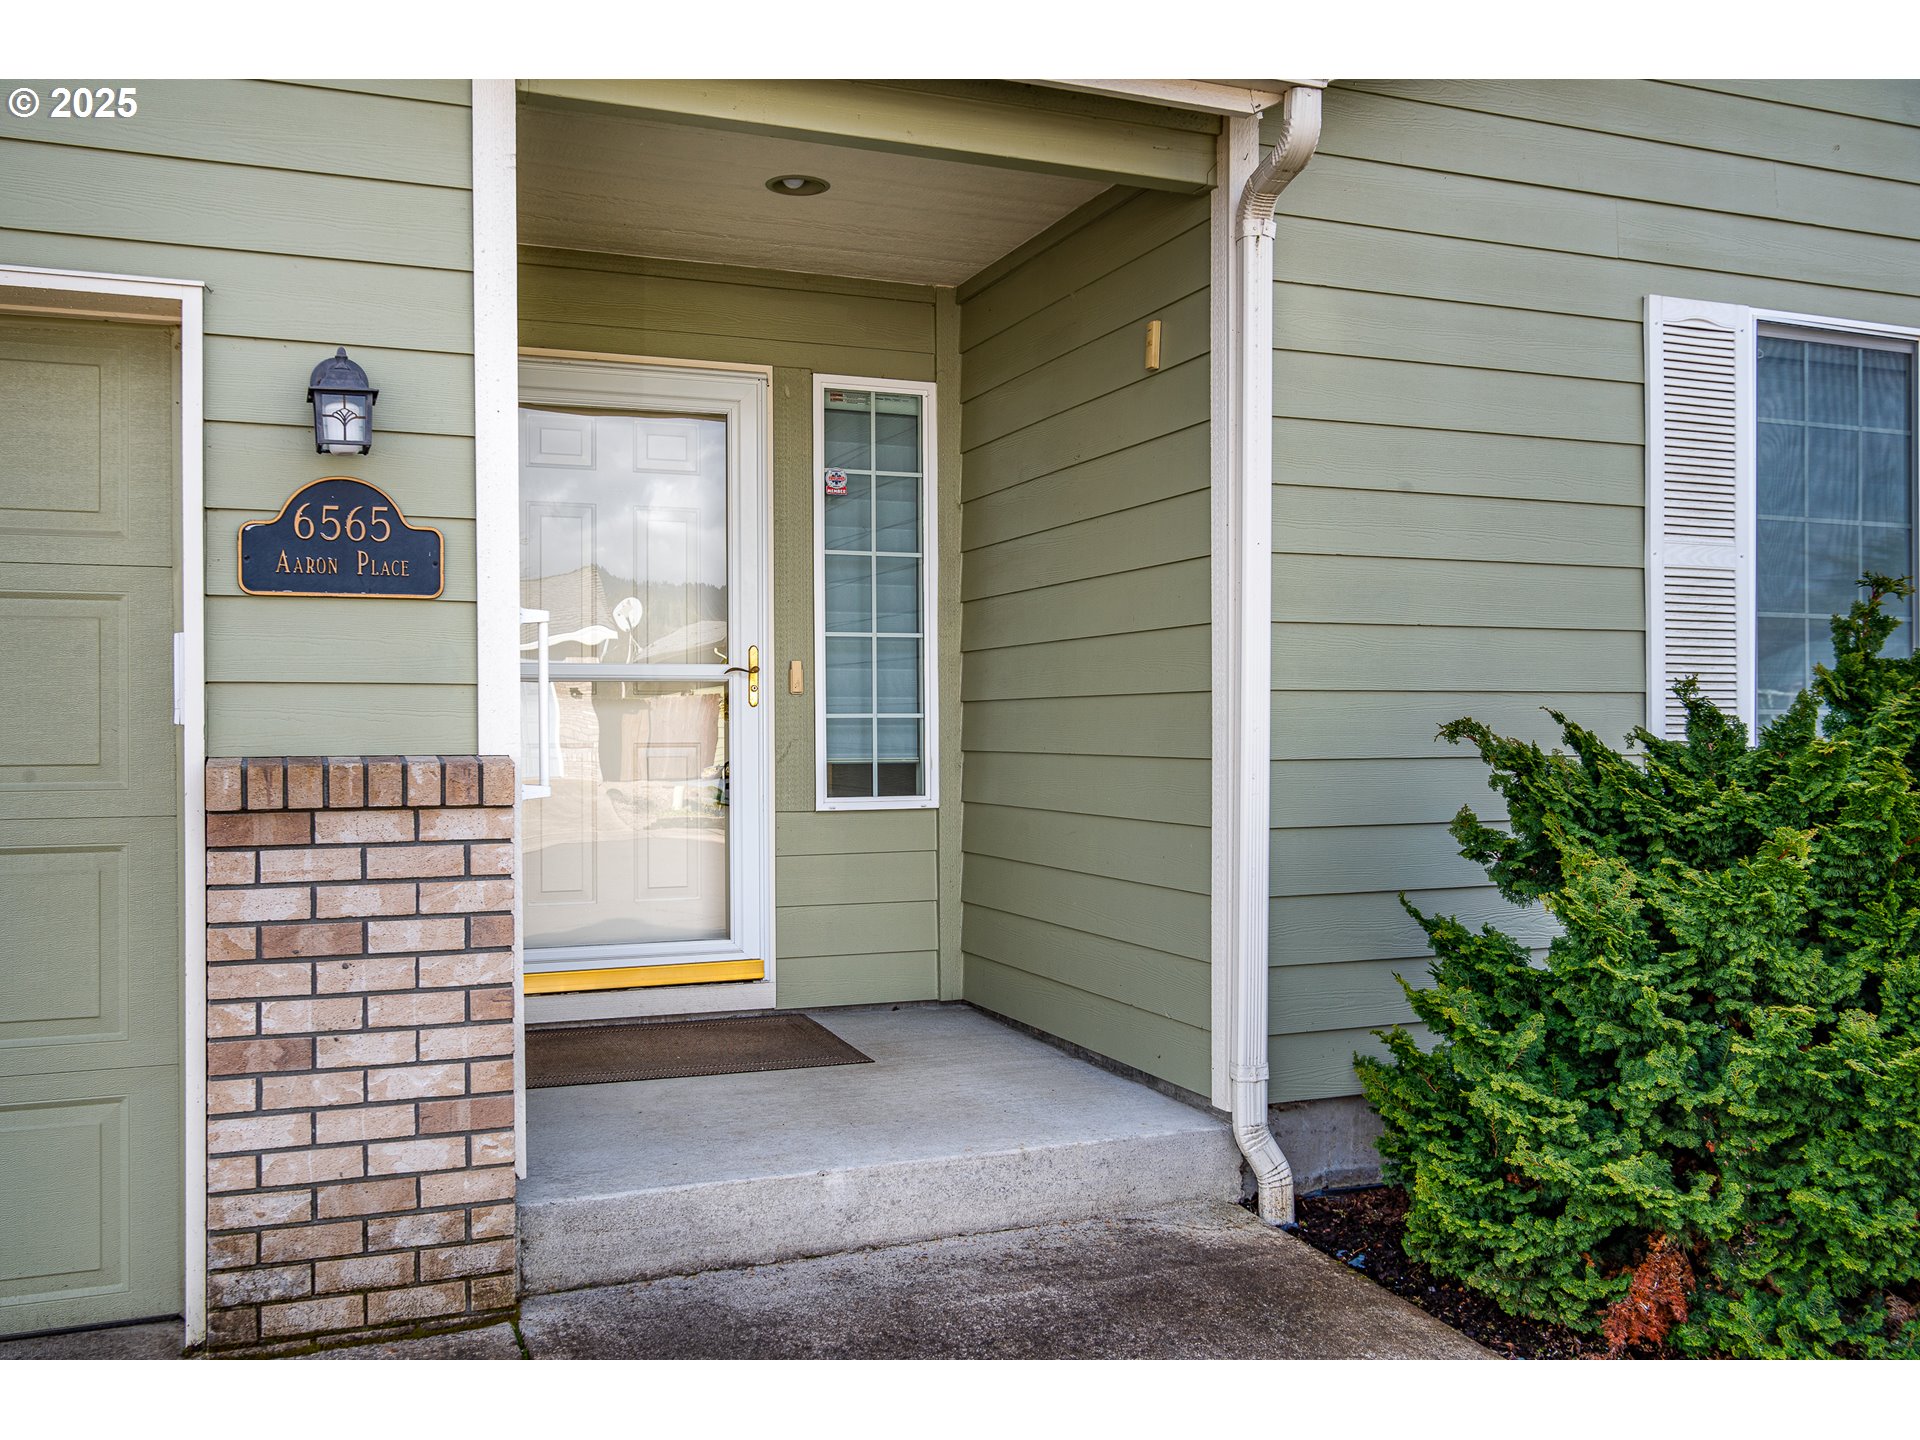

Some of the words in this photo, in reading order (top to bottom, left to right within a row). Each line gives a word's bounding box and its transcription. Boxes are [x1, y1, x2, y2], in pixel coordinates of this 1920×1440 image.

[293, 502, 391, 542] 6565
[275, 549, 338, 575] AARON
[356, 550, 410, 577] PLACE
